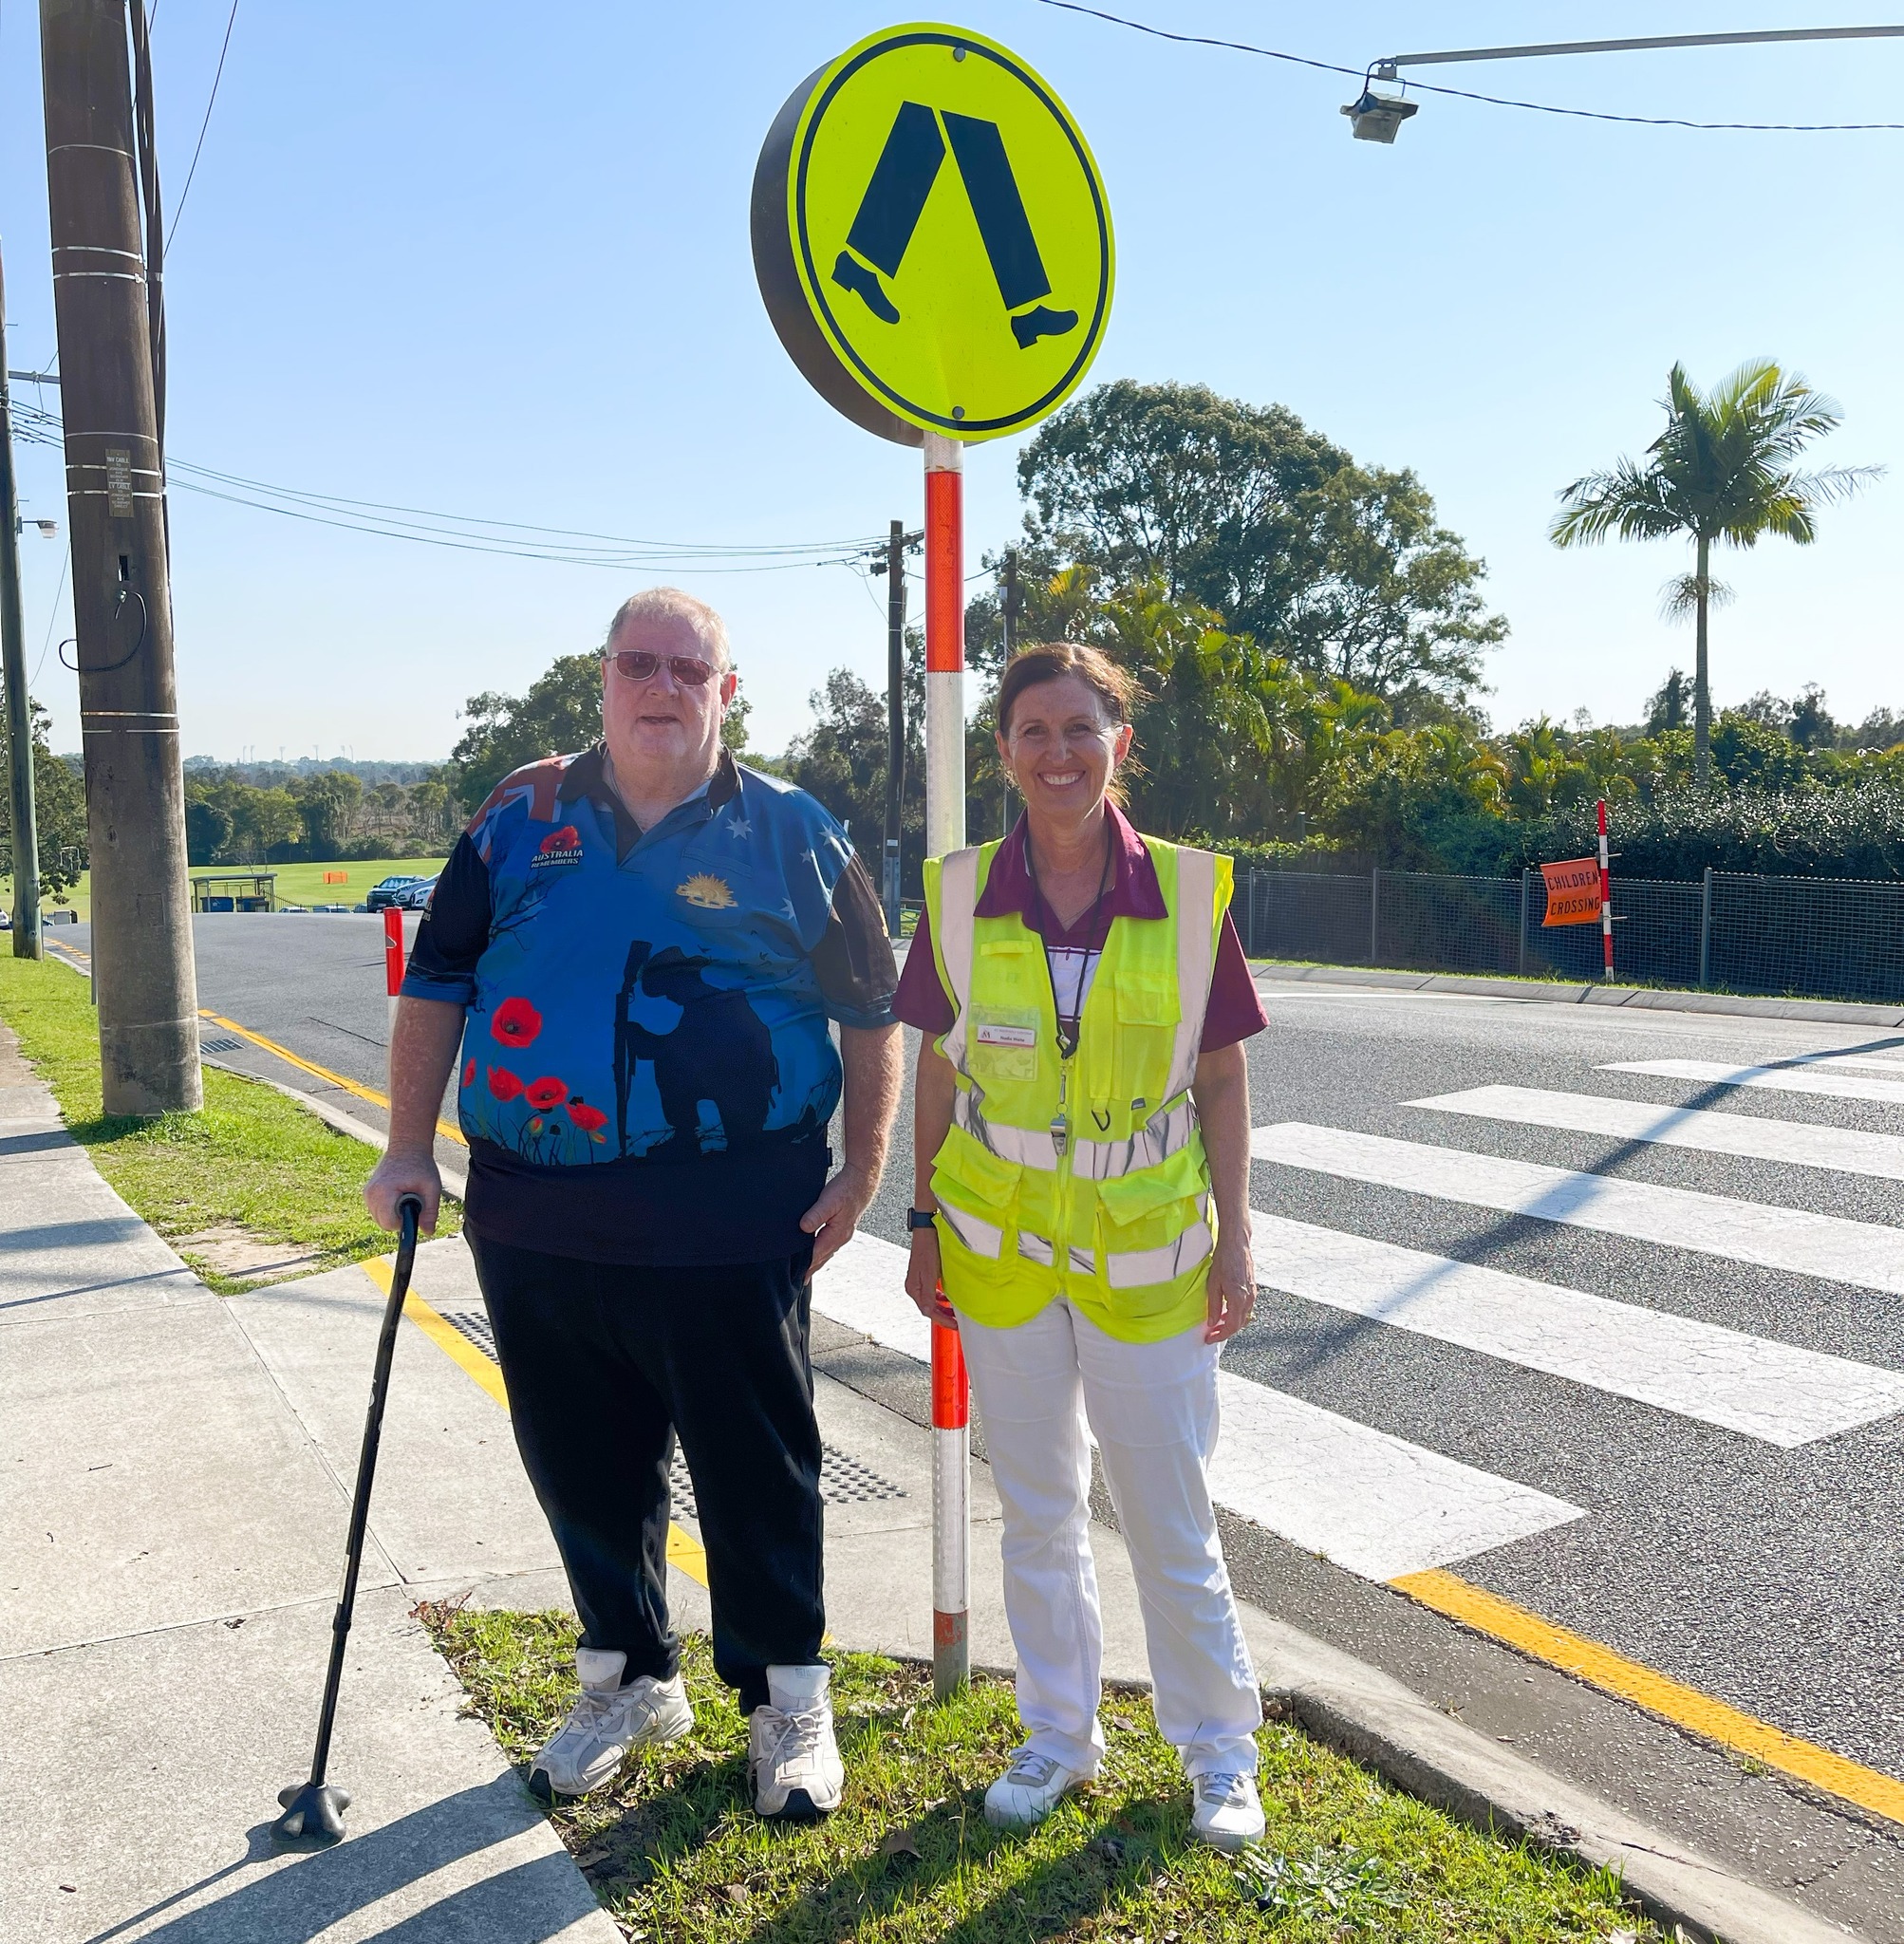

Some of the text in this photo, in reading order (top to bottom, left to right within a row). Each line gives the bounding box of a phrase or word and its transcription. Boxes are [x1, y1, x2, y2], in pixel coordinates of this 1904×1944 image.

[532, 850, 583, 862] AUSTRALIA
[532, 858, 579, 868] REMEMBERS
[1547, 871, 1598, 890] CHILDREN
[1550, 897, 1600, 916] CROSSING
